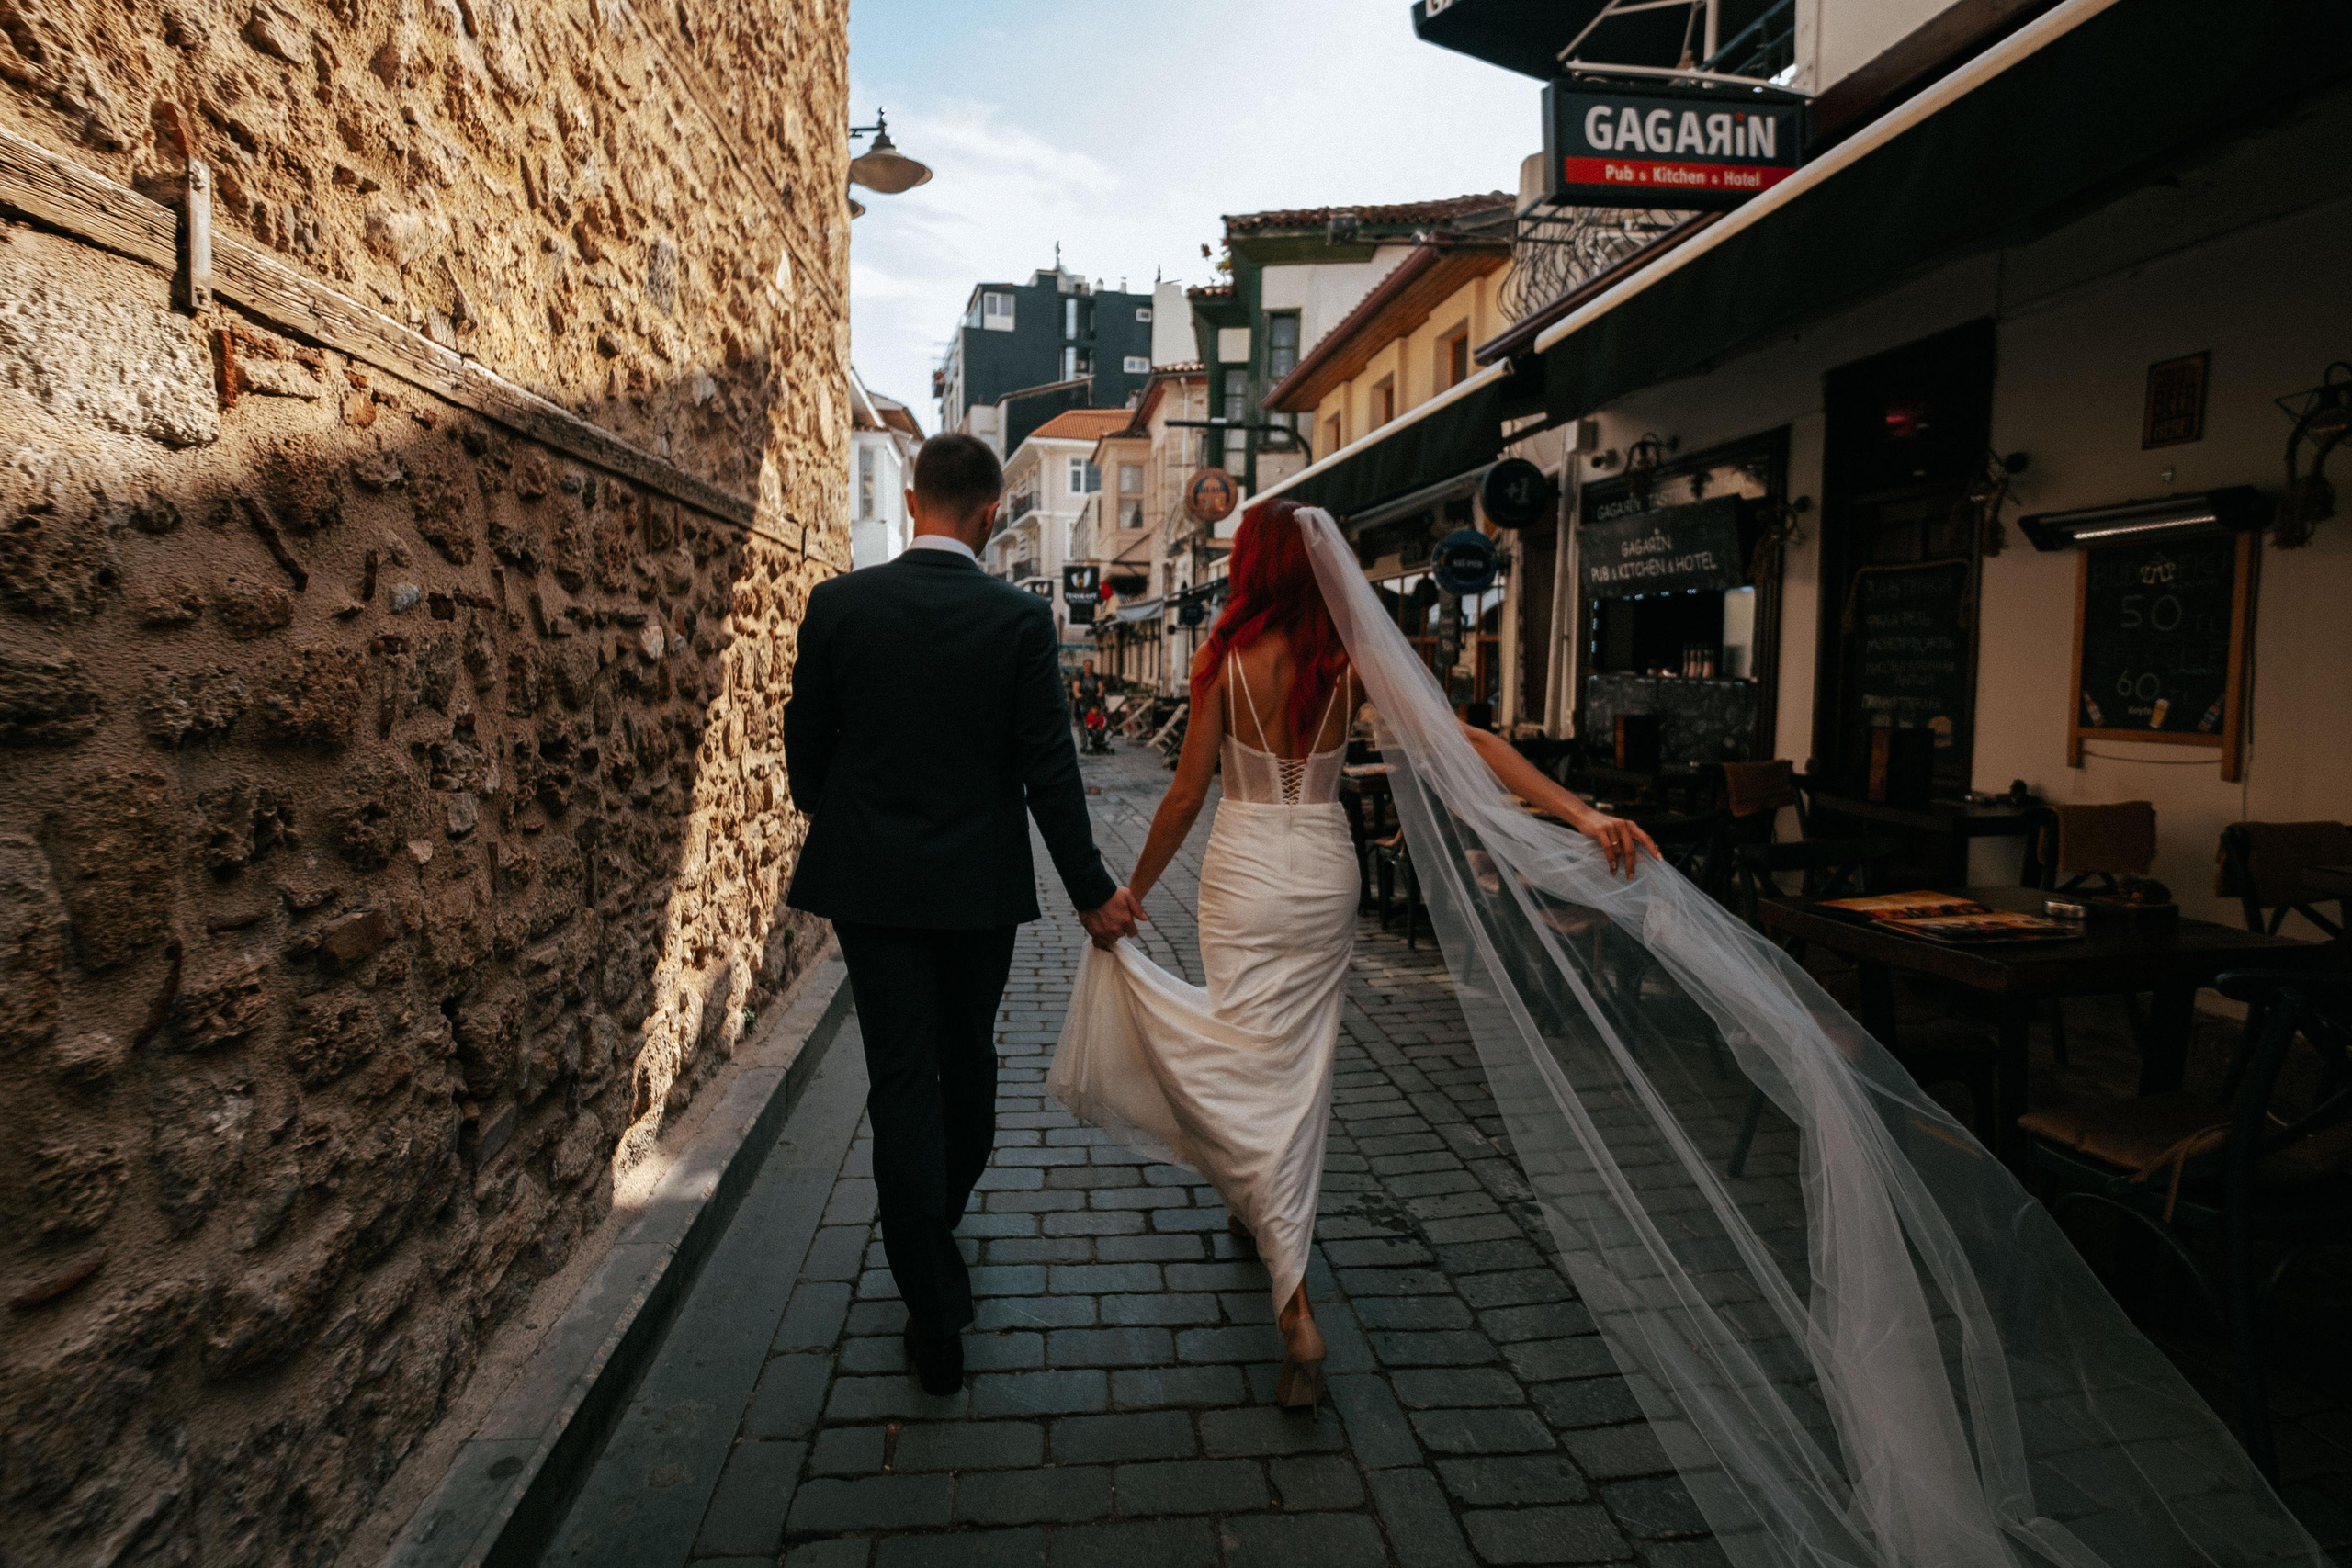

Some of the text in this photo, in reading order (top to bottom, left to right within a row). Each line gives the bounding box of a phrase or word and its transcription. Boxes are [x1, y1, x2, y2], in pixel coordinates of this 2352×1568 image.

[1605, 165, 1634, 181] Pub
[1654, 167, 1704, 185] Kitchen
[1724, 171, 1759, 186] Hotel
[1591, 564, 1610, 583] PUB
[1618, 558, 1666, 580] KITCHEN
[1675, 551, 1717, 573] HOTEL
[2120, 594, 2182, 631] 50
[2117, 669, 2159, 700] 60
